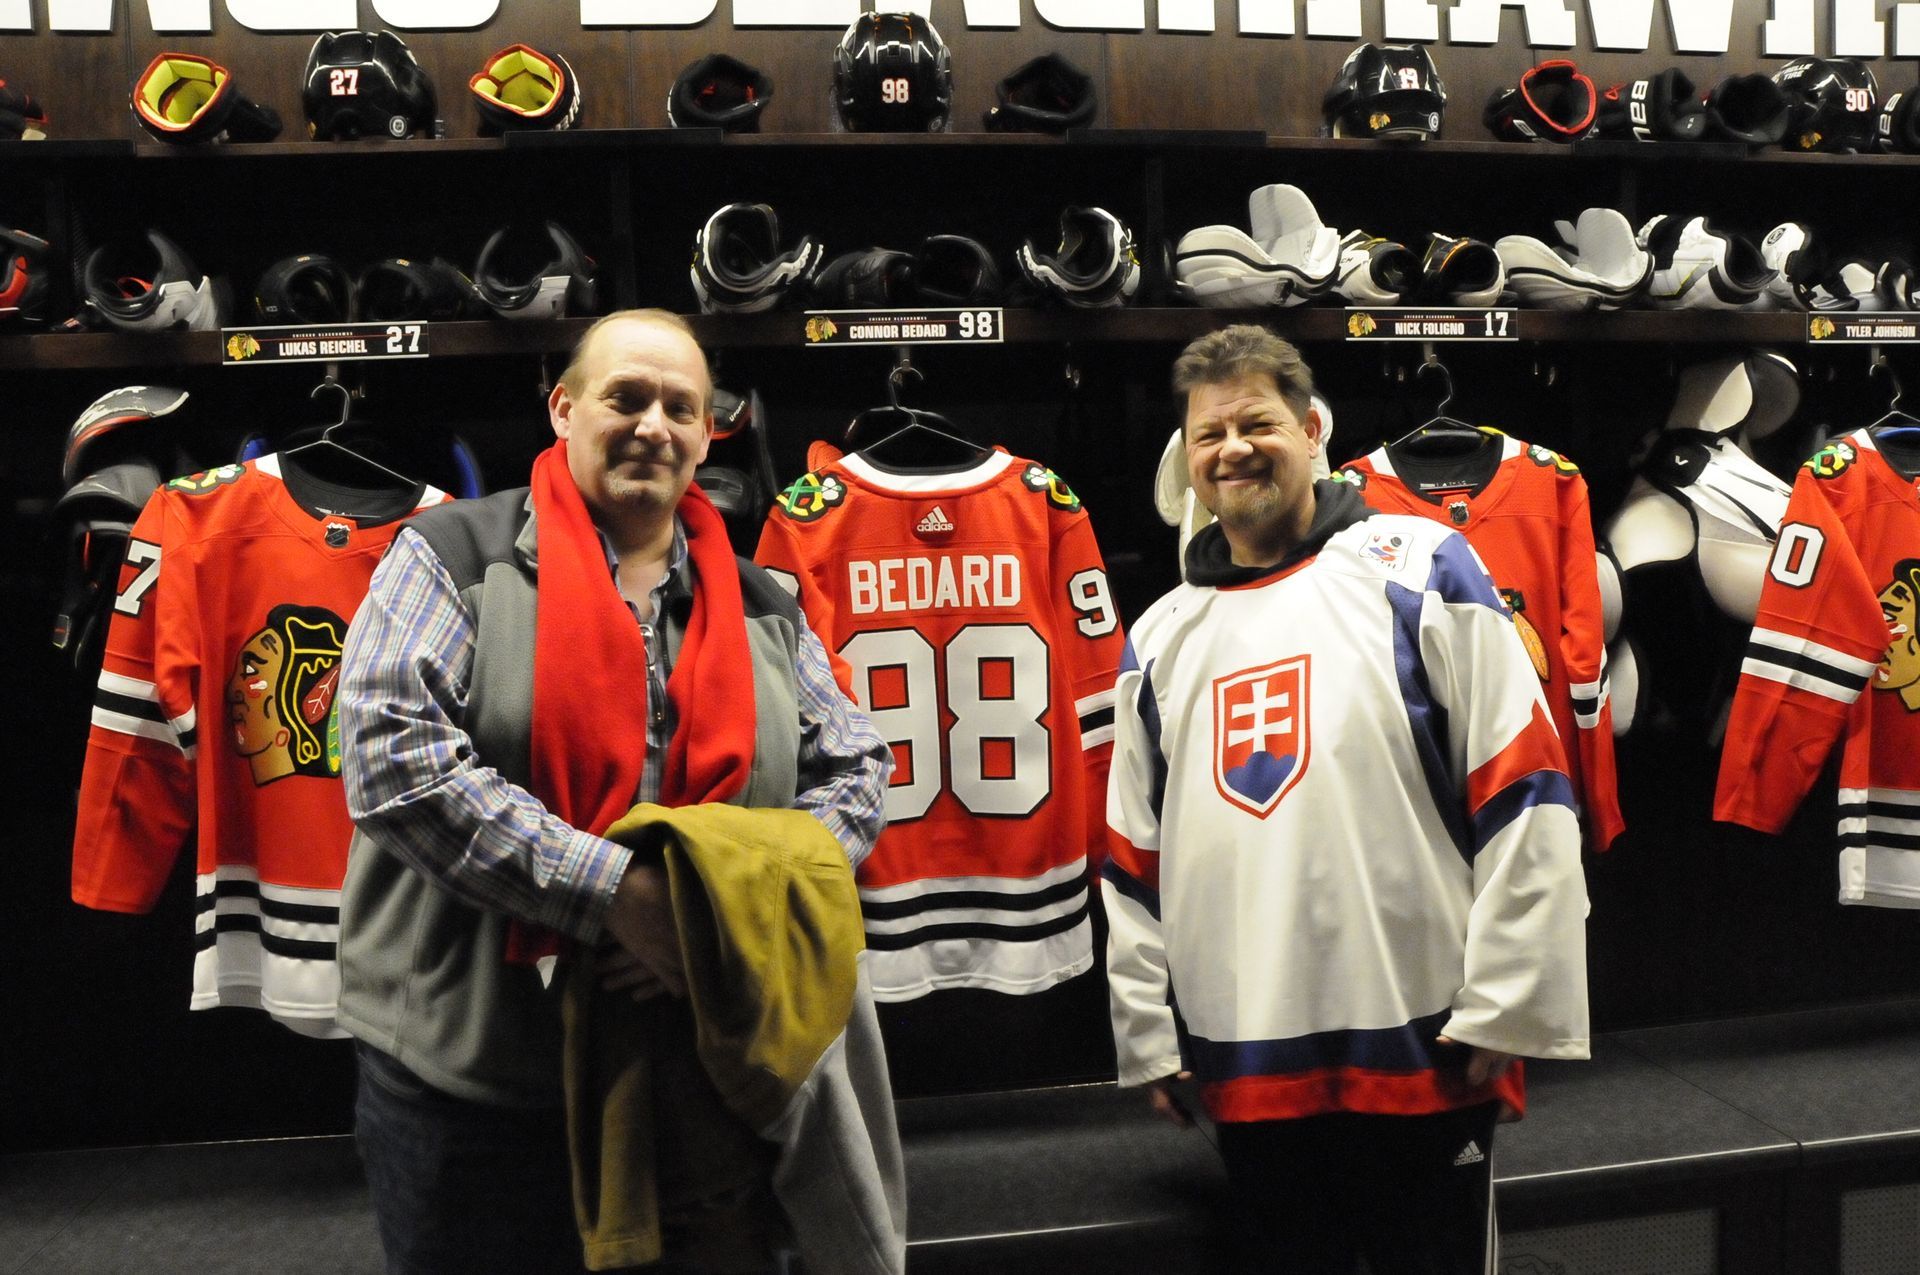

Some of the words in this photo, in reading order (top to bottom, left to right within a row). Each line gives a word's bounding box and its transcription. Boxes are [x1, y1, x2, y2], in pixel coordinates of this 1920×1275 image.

[330, 69, 358, 95] 27
[882, 78, 909, 103] 98
[1845, 90, 1868, 112] 90
[850, 325, 899, 339] CONNOR
[902, 324, 946, 338] BEDARD
[959, 312, 992, 338] 98
[1395, 322, 1420, 335] NICK
[1422, 322, 1465, 335] FOLIGNO
[1484, 312, 1509, 336] 17
[1846, 326, 1872, 337] TYLER
[1873, 326, 1916, 337] JOHNSON
[279, 341, 316, 356] LUKAS
[320, 340, 368, 355] REICHEL
[386, 326, 421, 353] 27
[916, 522, 954, 532] adidas
[1769, 523, 1824, 587] 0
[114, 539, 162, 615] 7
[849, 554, 1021, 614] BEDARD
[1069, 568, 1118, 637] 9
[836, 624, 1051, 823] 98
[1453, 1153, 1485, 1166] adidas
